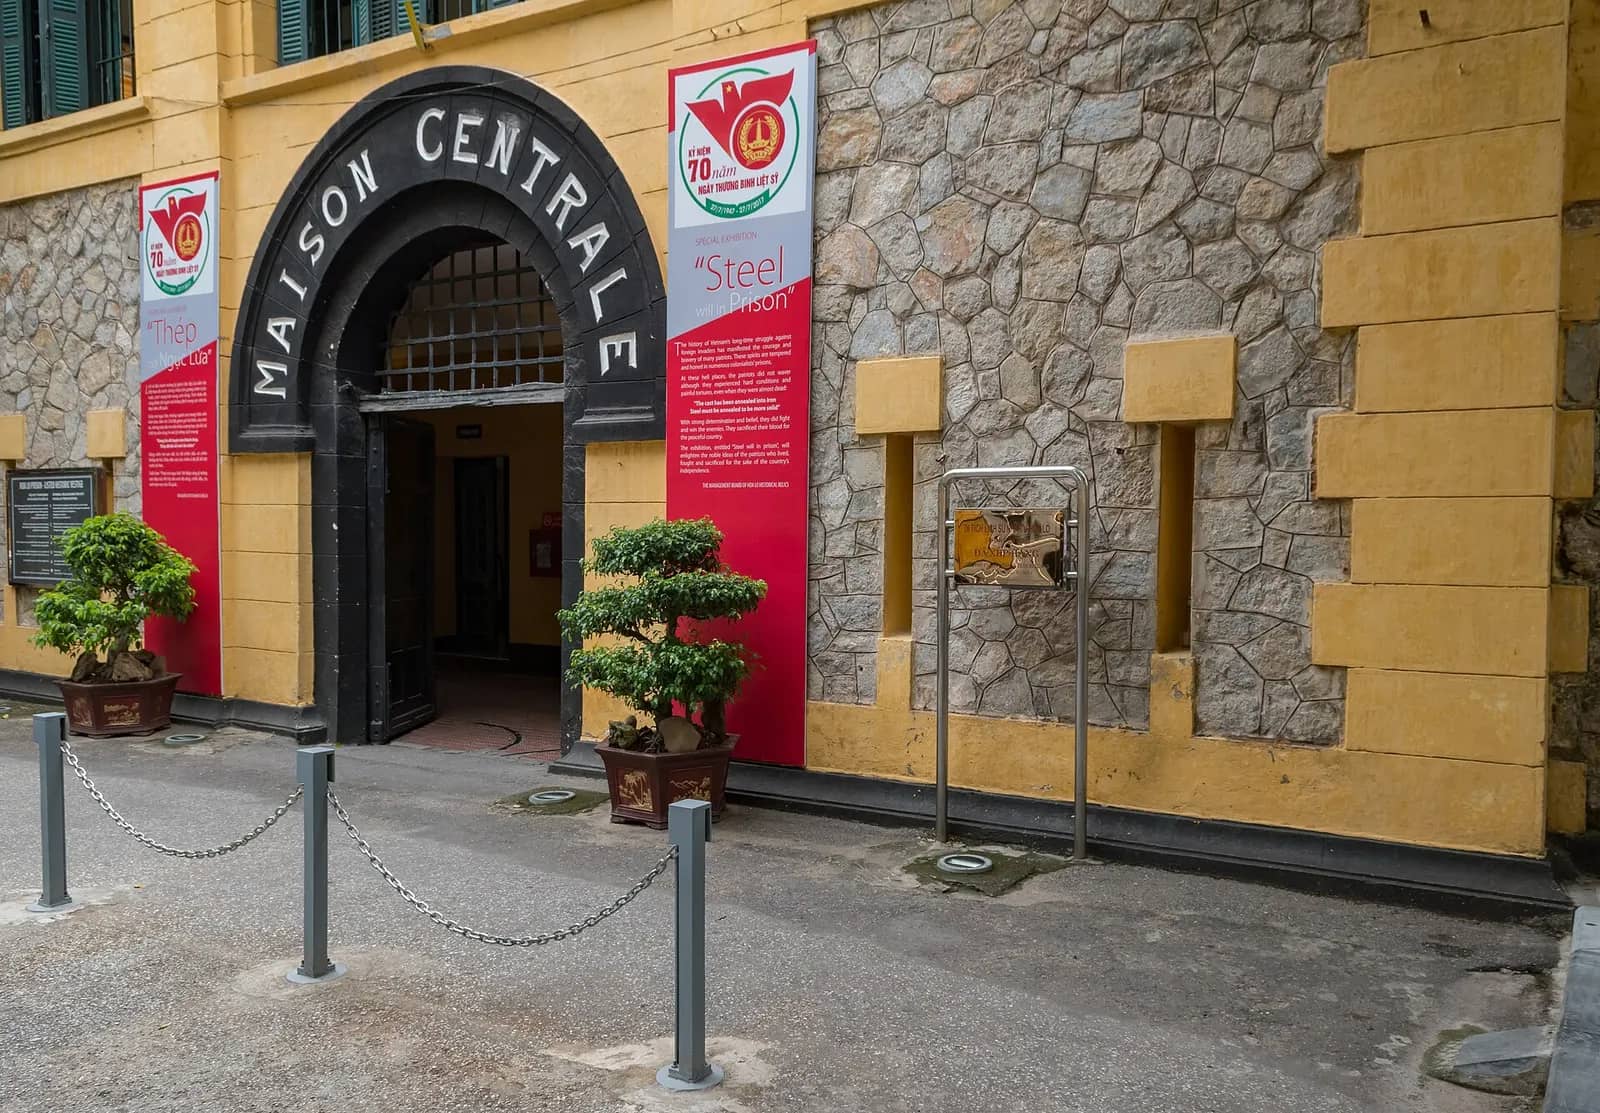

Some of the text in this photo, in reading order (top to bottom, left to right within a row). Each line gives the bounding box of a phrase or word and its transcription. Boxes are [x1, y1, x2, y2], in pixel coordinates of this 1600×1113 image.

[688, 158, 736, 182] 70 năm
[698, 183, 714, 195] NGÀY
[715, 180, 738, 192] THƯƠNG
[740, 178, 754, 189] BINH
[756, 175, 768, 187] LIỆT
[739, 196, 764, 213] 27/7/2017
[695, 232, 757, 246] SPECIAL EXHIBITION
[151, 251, 163, 268] 70
[253, 108, 638, 400] MAISON CENTRALE
[696, 303, 714, 317] will
[716, 303, 725, 314] in
